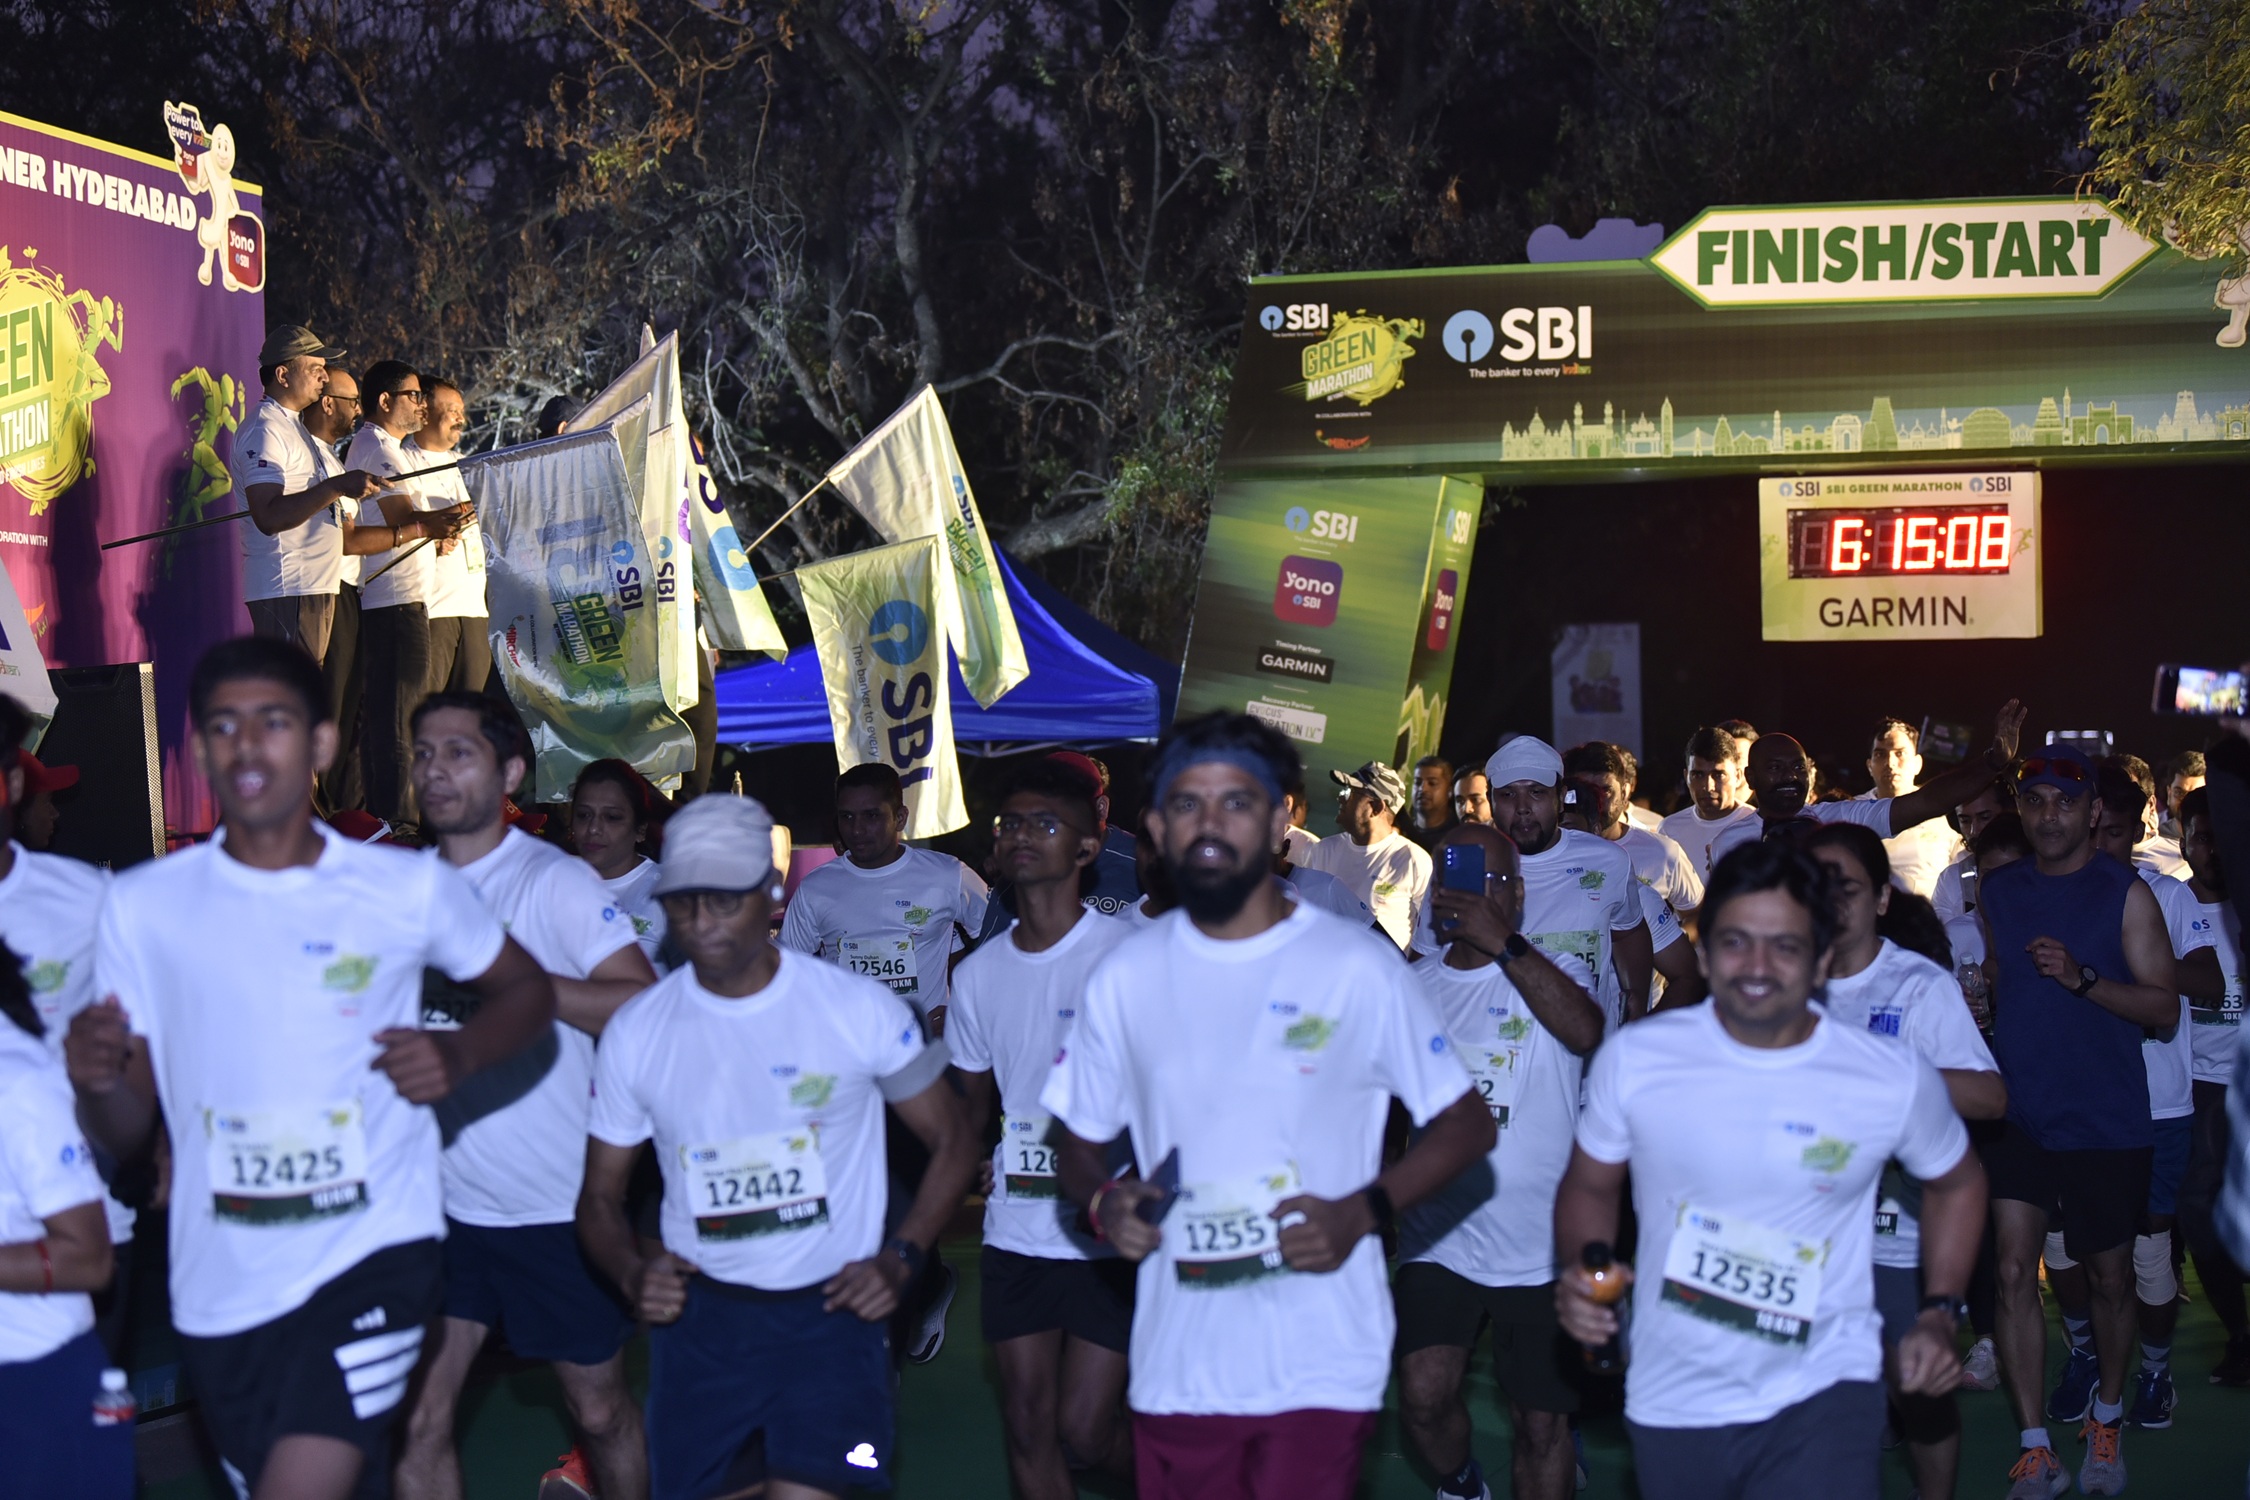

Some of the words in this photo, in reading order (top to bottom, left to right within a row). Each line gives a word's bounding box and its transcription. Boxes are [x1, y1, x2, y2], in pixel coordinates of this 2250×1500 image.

[166, 106, 190, 128] Power
[191, 117, 200, 131] to
[171, 126, 192, 145] every
[53, 160, 197, 231] HYDERABAD
[230, 230, 255, 253] yono
[1697, 218, 2111, 286] FINISH/START
[240, 254, 250, 269] SBI
[1286, 303, 1329, 331] SBI
[1500, 305, 1592, 362] SBI
[1305, 326, 1376, 377] GREEN
[1308, 362, 1373, 399] MARATHON
[1469, 368, 1487, 378] The
[1488, 367, 1521, 378] banker
[1523, 367, 1532, 377] to
[1534, 367, 1560, 378] every
[1795, 481, 1820, 496] SBI
[1826, 484, 1845, 493] SBI
[1849, 484, 1889, 493] GREEN
[1892, 482, 1962, 492] MARATHON
[1986, 476, 2012, 492] SBI
[30, 535, 48, 547] WITH
[1311, 510, 1358, 543] SBI
[1453, 510, 1472, 545] SBI
[1830, 515, 2012, 571] 6:15:08
[616, 567, 644, 612] SBI
[657, 562, 675, 603] SBI
[1283, 571, 1335, 595] yono
[1302, 595, 1321, 609] SBI
[1819, 596, 1967, 628] GARMIN
[555, 601, 592, 666] MARATHON
[574, 592, 624, 663] GREEN
[852, 643, 863, 667] The
[1262, 654, 1327, 676] GARMIN
[856, 668, 872, 709] banker
[863, 710, 874, 723] to
[881, 671, 934, 790] SBI
[866, 725, 880, 758] every
[849, 958, 905, 976] 12546
[232, 1146, 343, 1187] 12425
[707, 1168, 804, 1208] 12442
[1185, 1216, 1266, 1252] 1255
[1690, 1250, 1798, 1306] 12535
